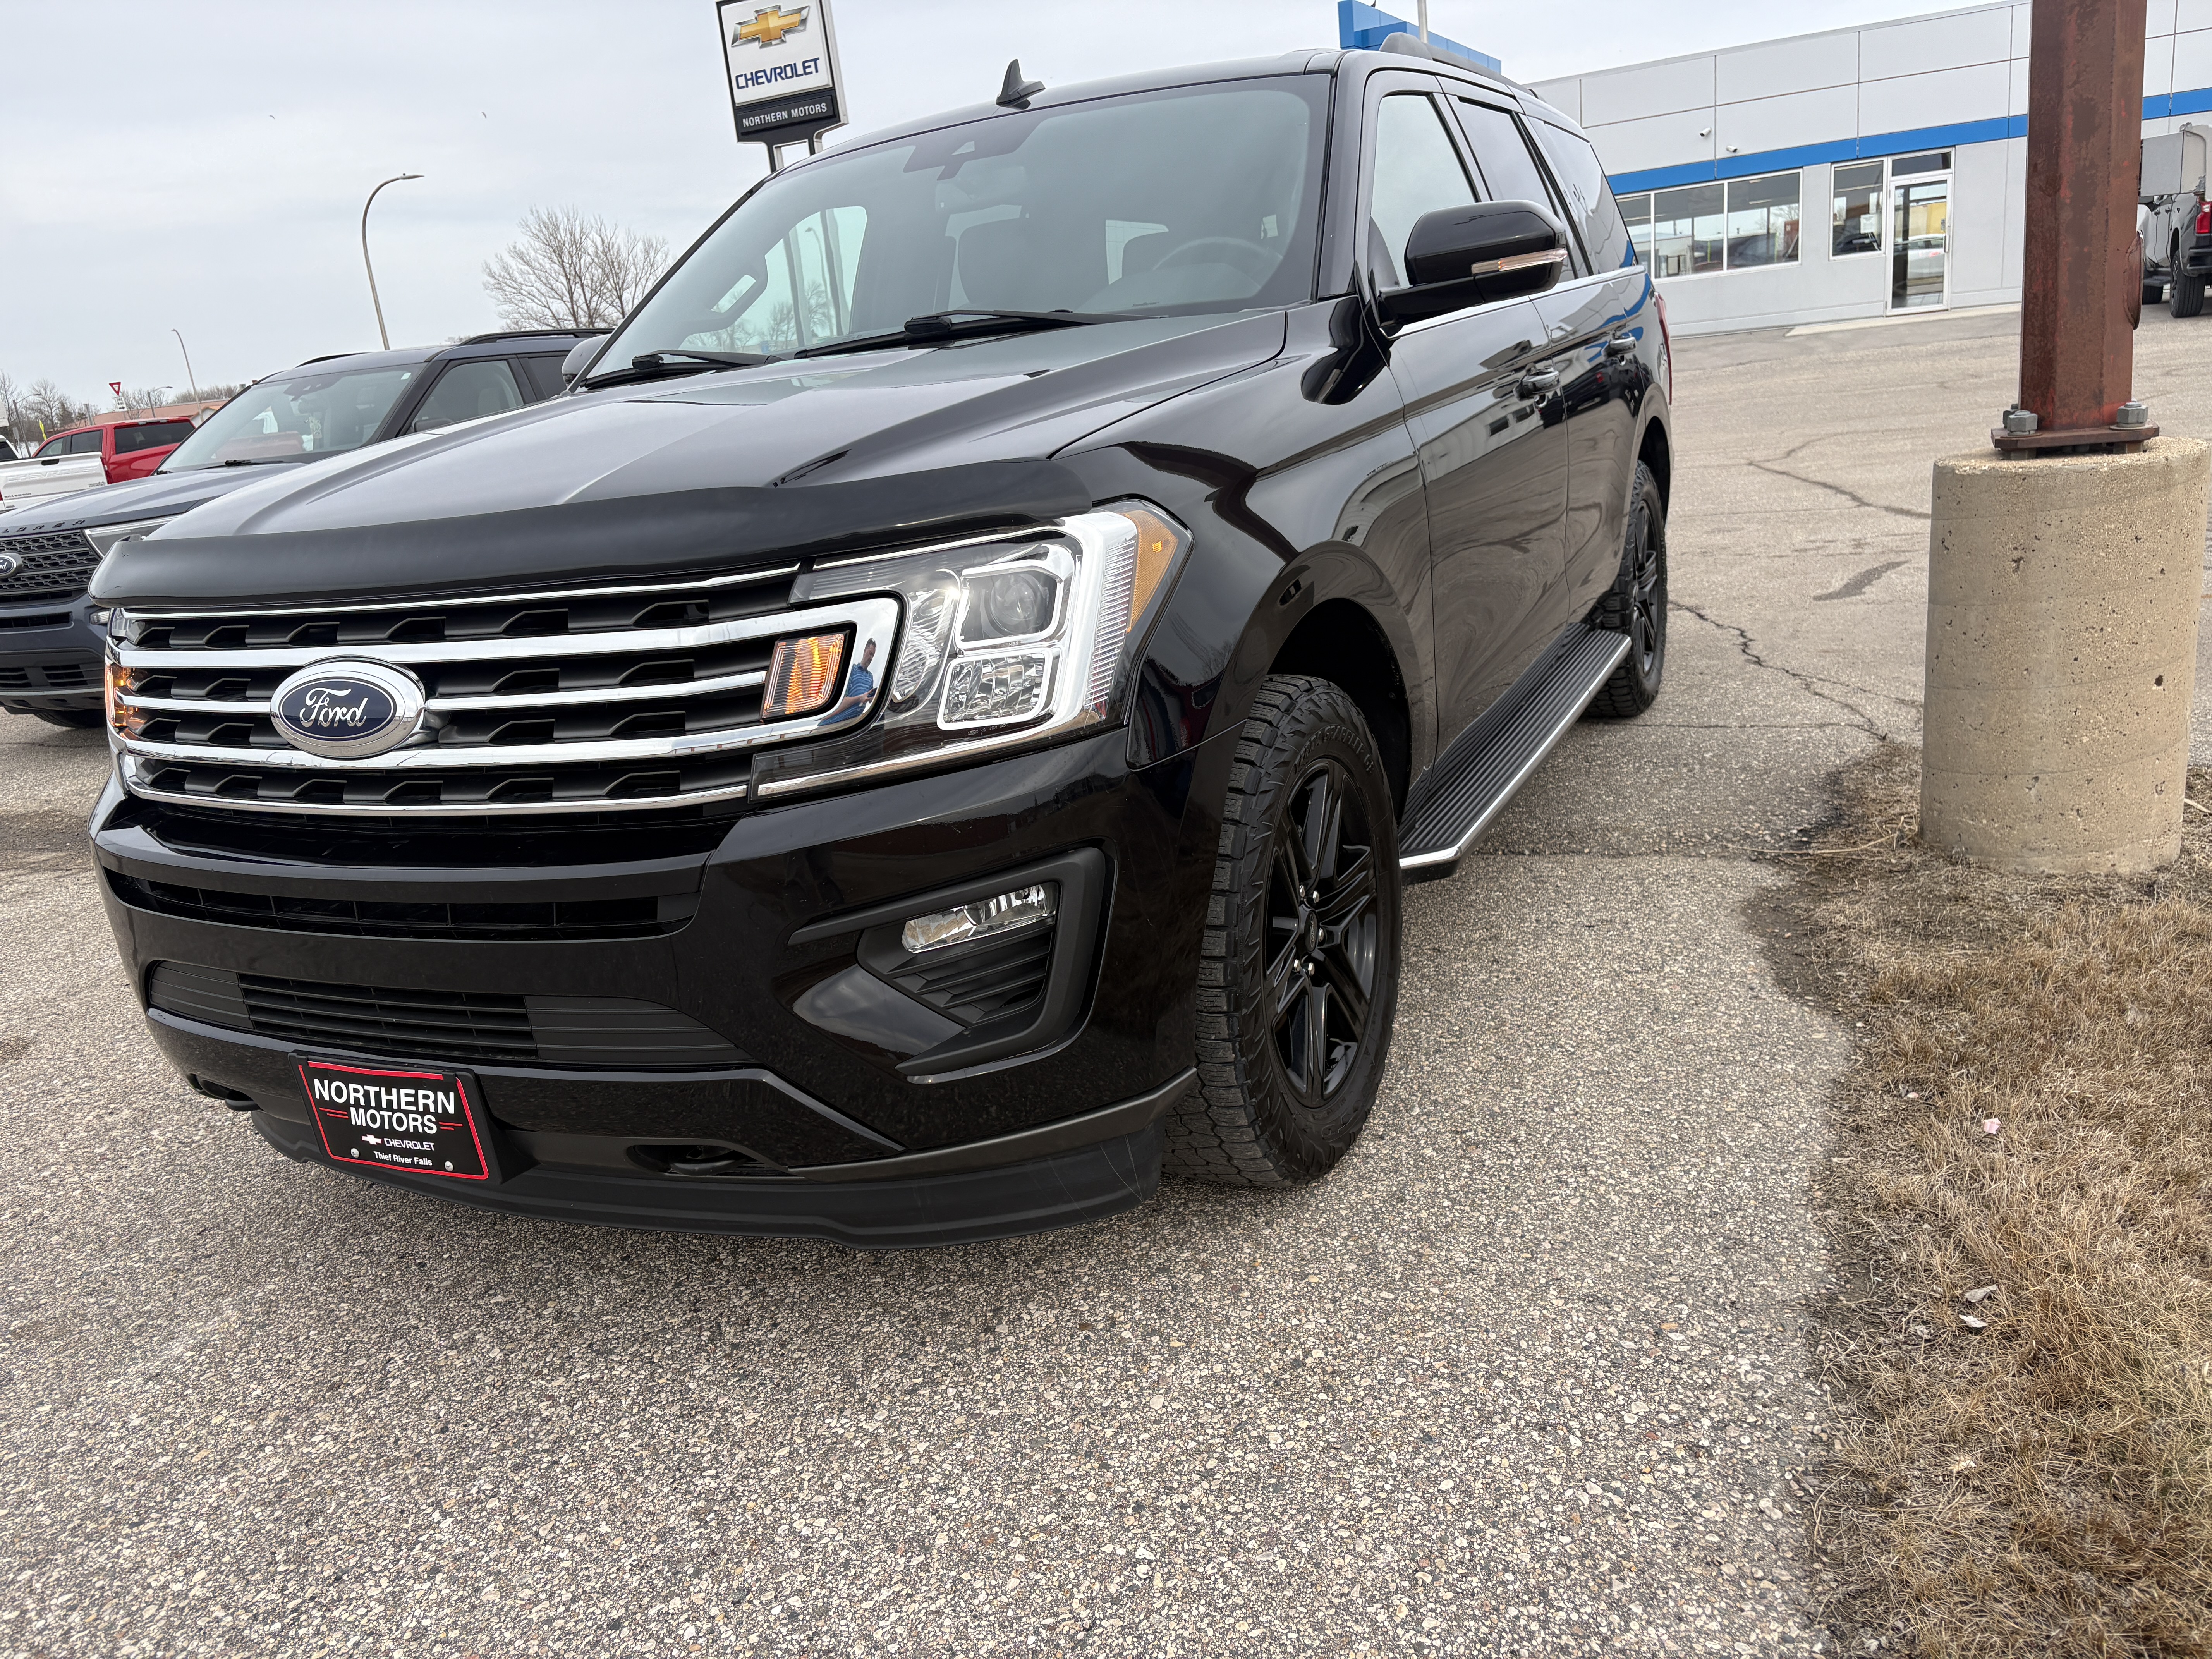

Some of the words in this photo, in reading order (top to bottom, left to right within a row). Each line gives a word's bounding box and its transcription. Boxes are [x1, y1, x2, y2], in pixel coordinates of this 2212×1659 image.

[735, 57, 820, 89] CHEVROLET
[742, 111, 788, 127] NORTHERN
[792, 103, 827, 118] MOTORS
[299, 687, 369, 728] Ford
[314, 1079, 455, 1114] NORTHERN
[350, 1107, 437, 1134] MOTORS
[384, 1138, 435, 1151] CHEVROLET
[373, 1151, 392, 1161] Thief
[393, 1154, 412, 1164] River
[414, 1157, 433, 1166] Falls
